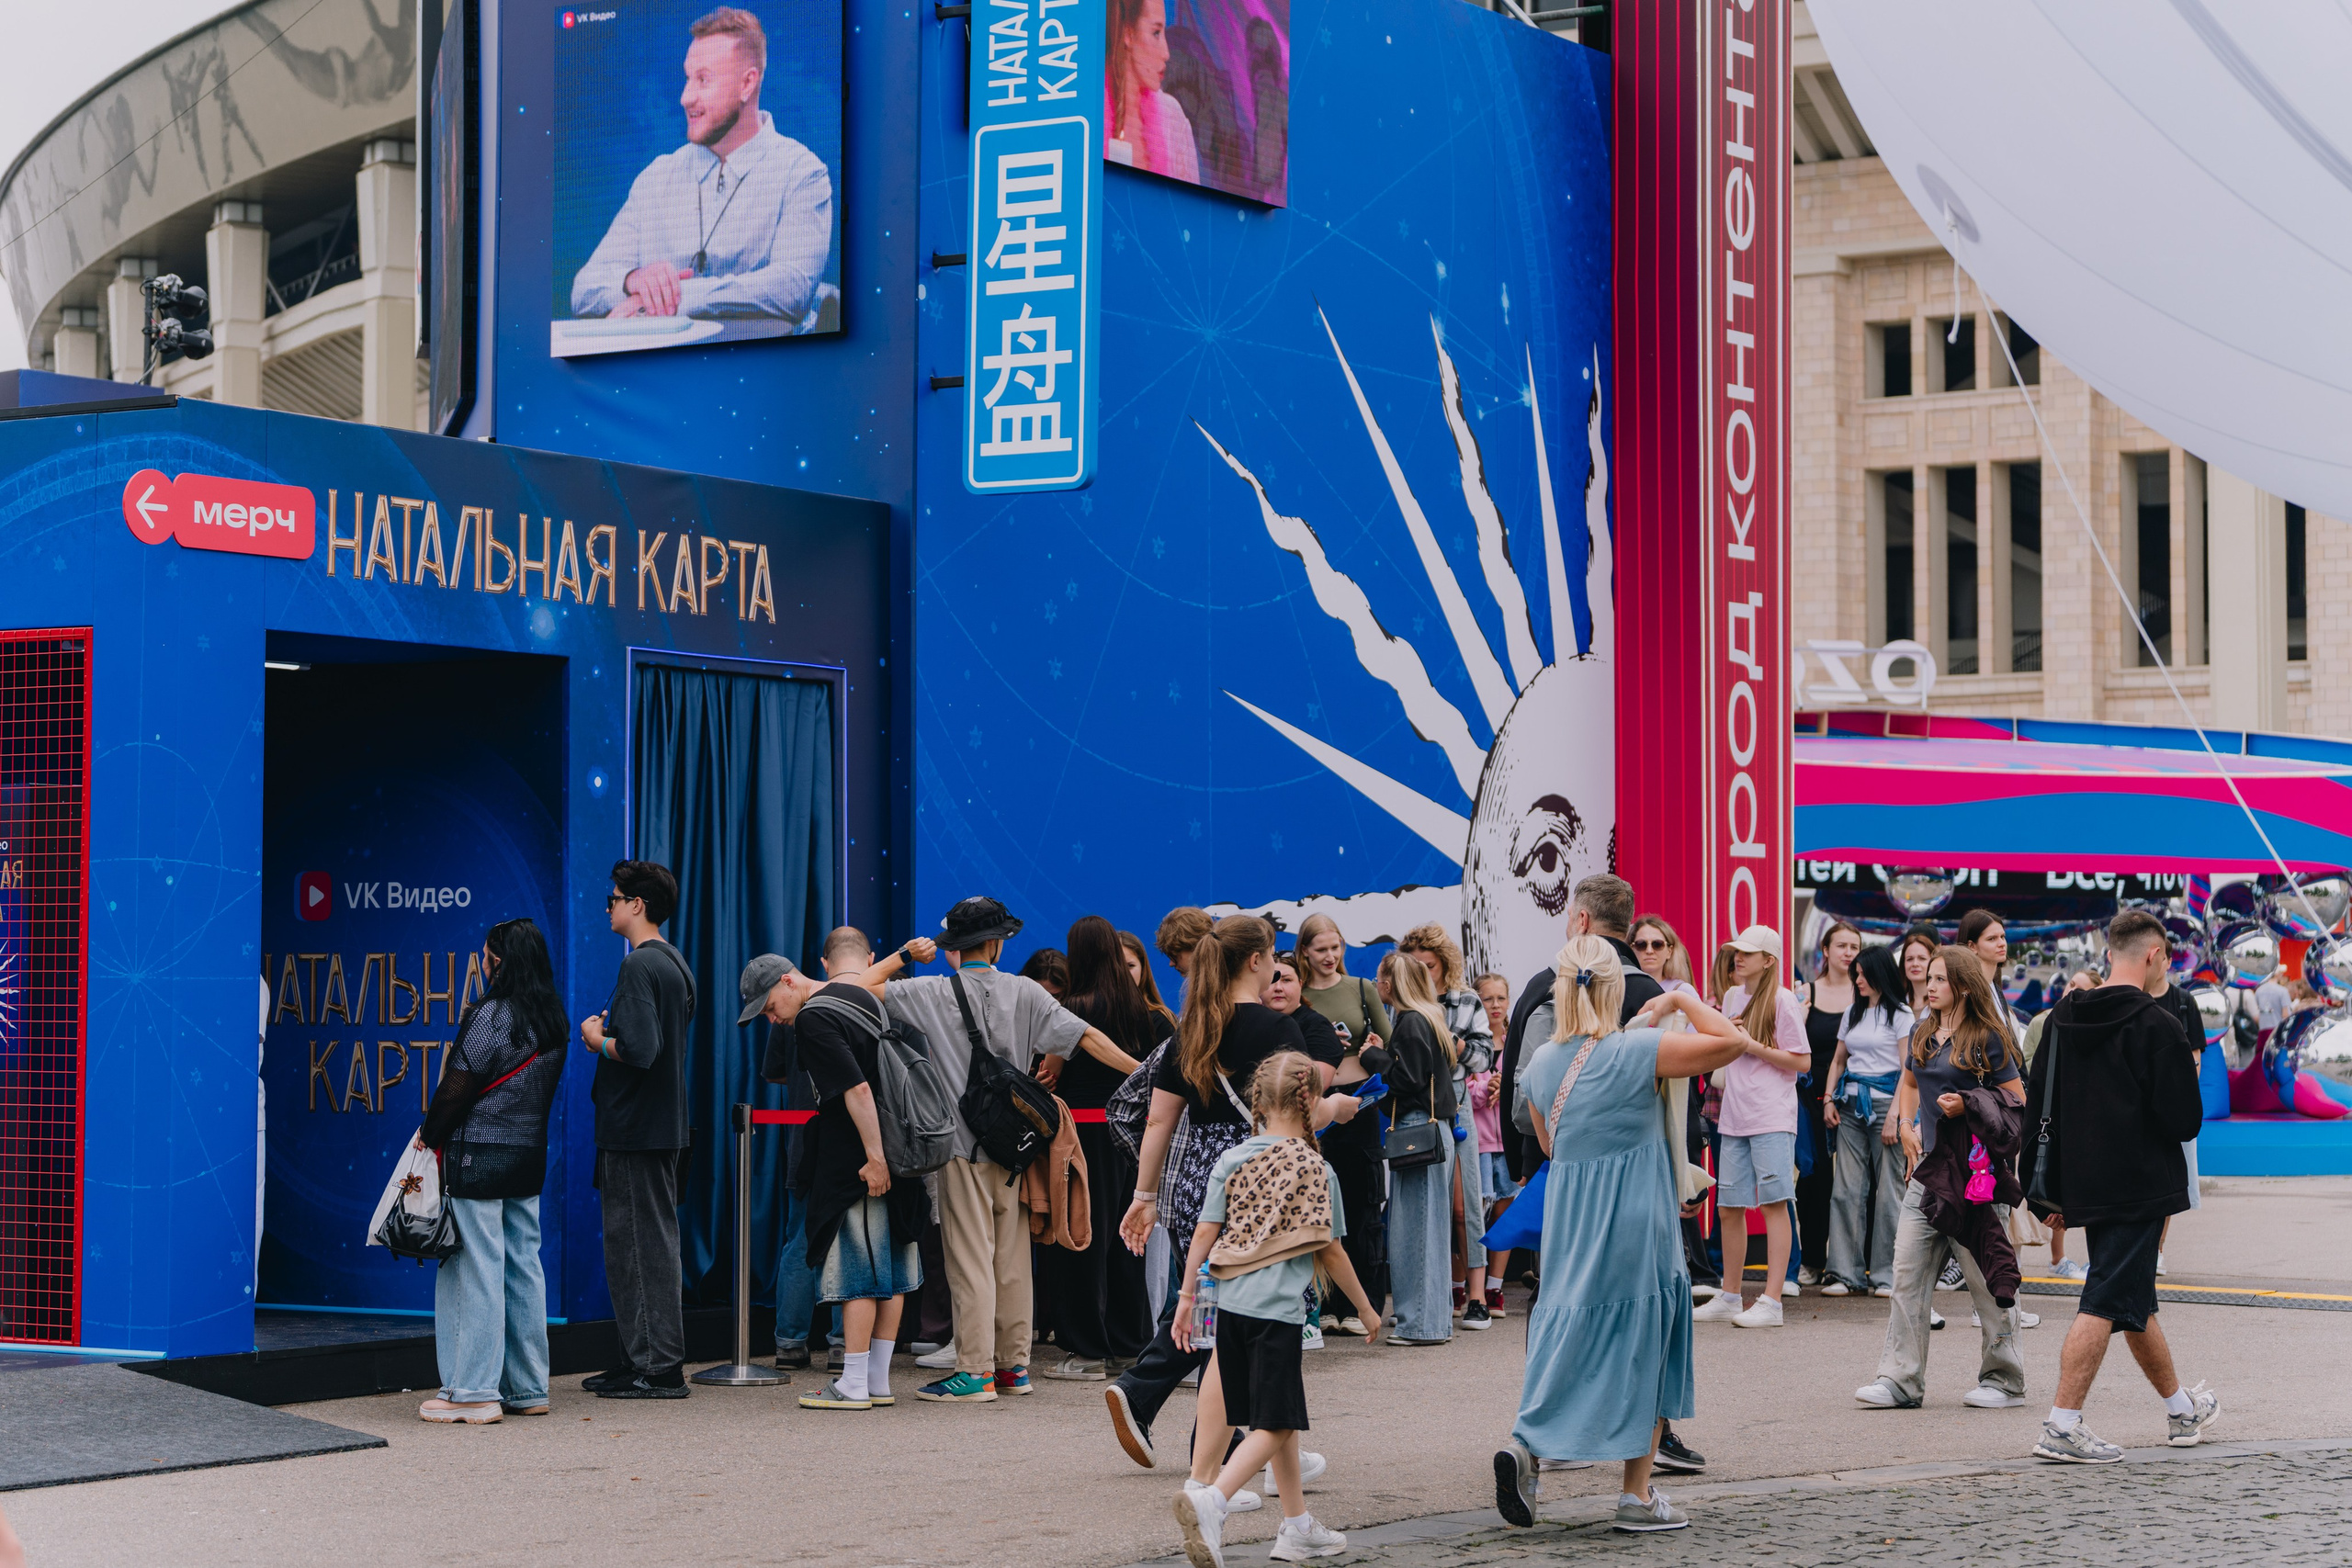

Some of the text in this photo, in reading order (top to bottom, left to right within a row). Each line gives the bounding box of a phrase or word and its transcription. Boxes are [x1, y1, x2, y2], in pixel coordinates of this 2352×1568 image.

[1725, 0, 1766, 941] ород контент
[193, 498, 296, 536] мерч
[327, 488, 776, 626] НАТАЛЬНАЯ КАРТА
[345, 880, 471, 913] VK Видео
[265, 952, 484, 1026] АТАЛЬНА
